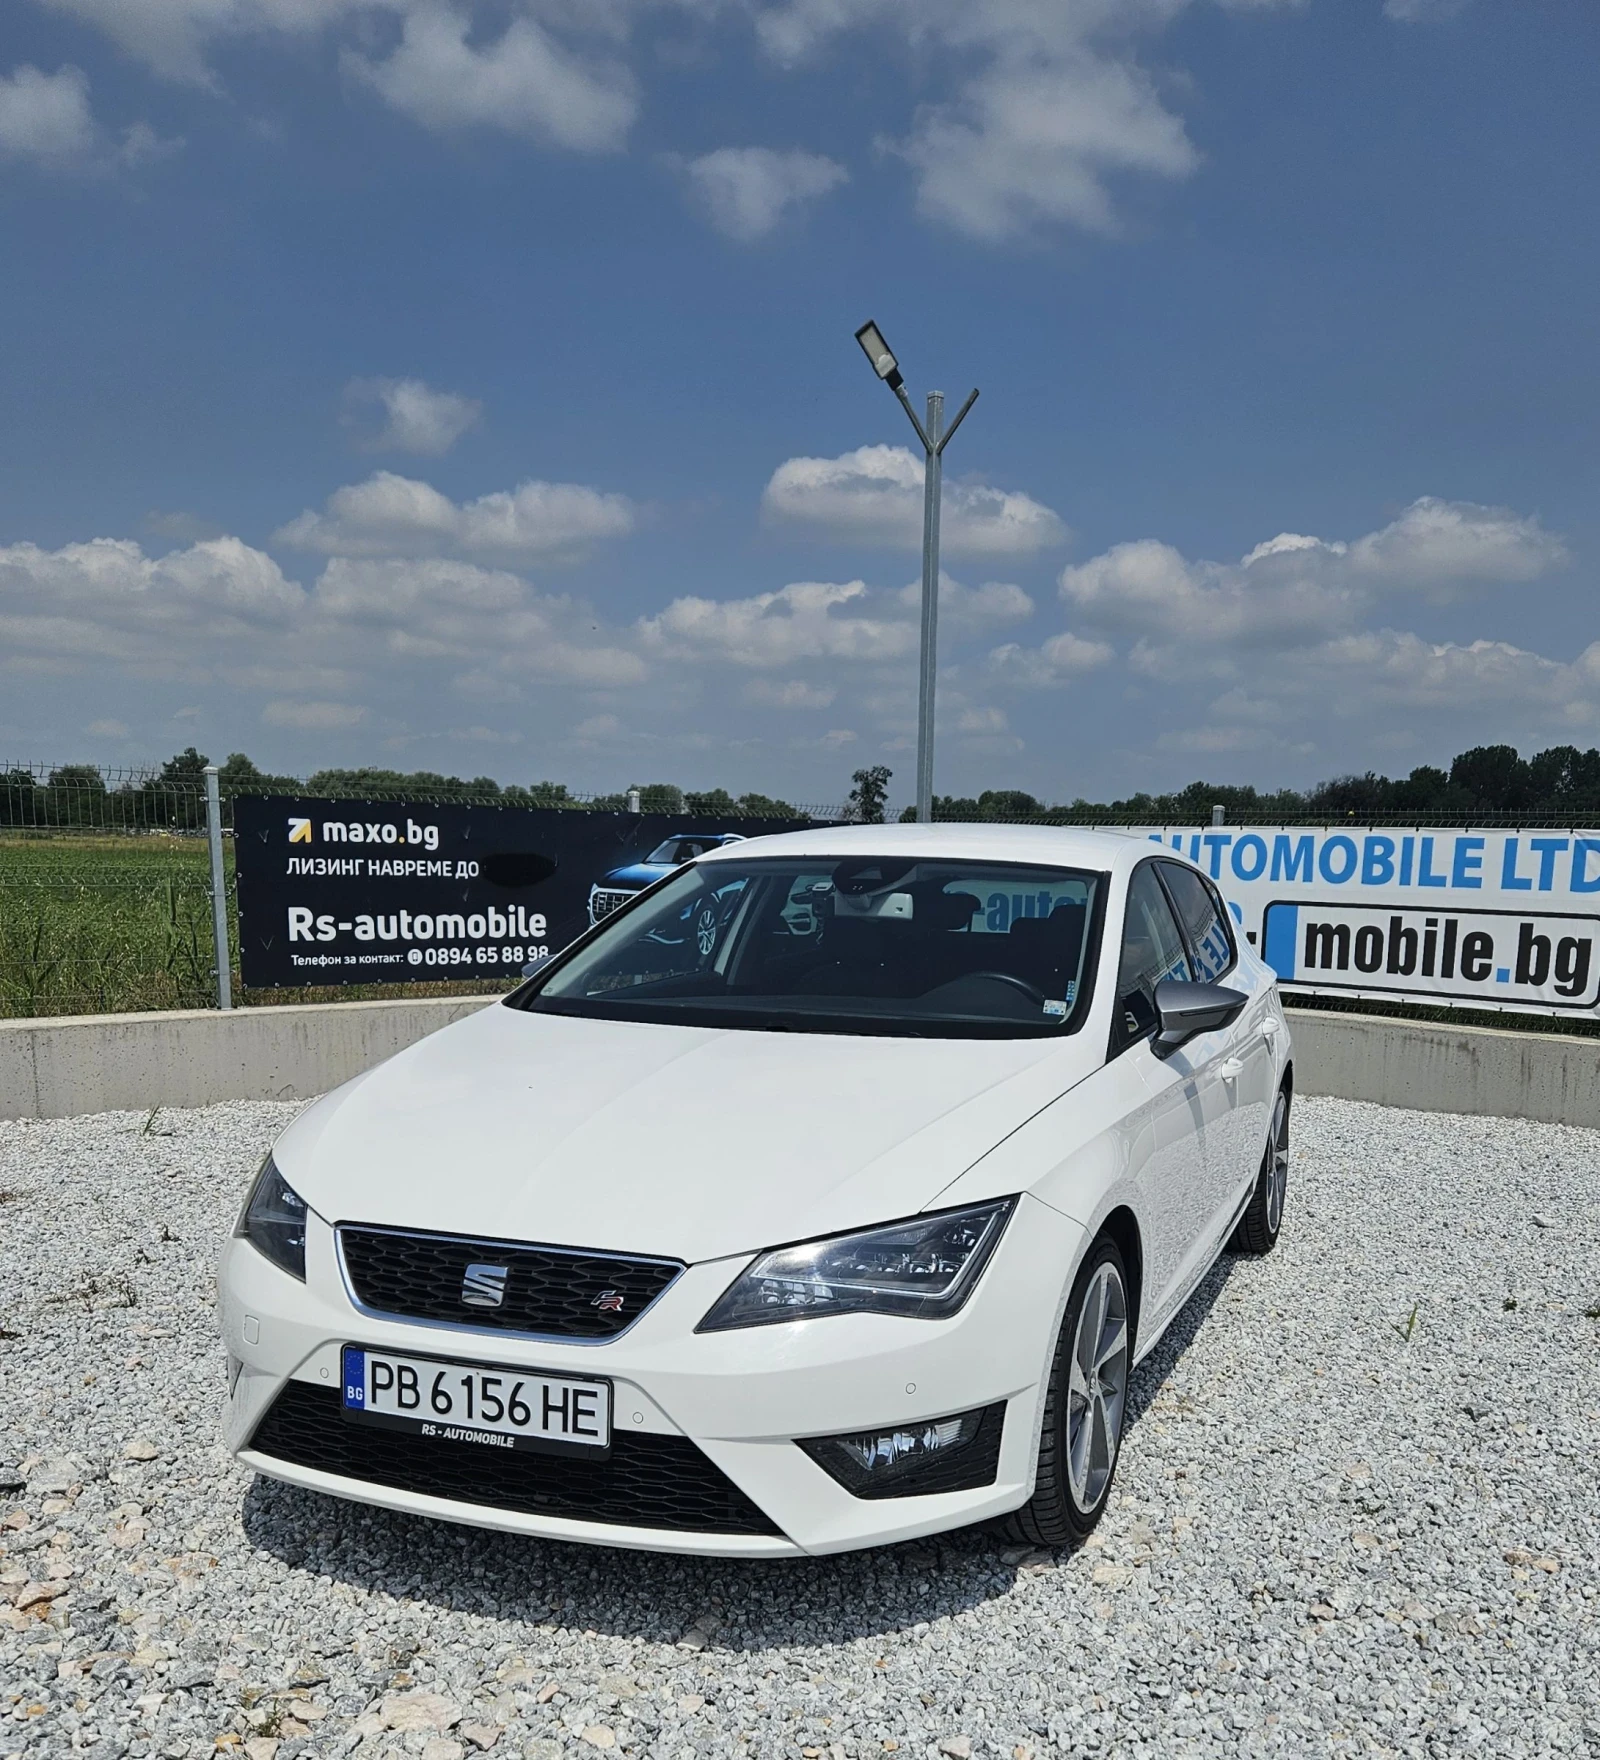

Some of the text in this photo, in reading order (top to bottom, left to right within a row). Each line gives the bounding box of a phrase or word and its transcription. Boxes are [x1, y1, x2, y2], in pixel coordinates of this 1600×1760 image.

[323, 818, 439, 850] maxo.bg
[286, 858, 480, 879] ЛИЗИНГ НАВРЕМЕ ДО
[1148, 832, 1600, 893] TOMOBILE LTD
[288, 904, 547, 942] Rs-automobile
[291, 945, 549, 967] Телефон за контакт: 0894 65 88 98
[1303, 915, 1593, 997] mobile.bg
[590, 1290, 624, 1311] FR
[347, 1360, 598, 1437] BG PB 6156 HE
[421, 1423, 436, 1436] RS
[443, 1427, 515, 1448] AUTOMOBILE
